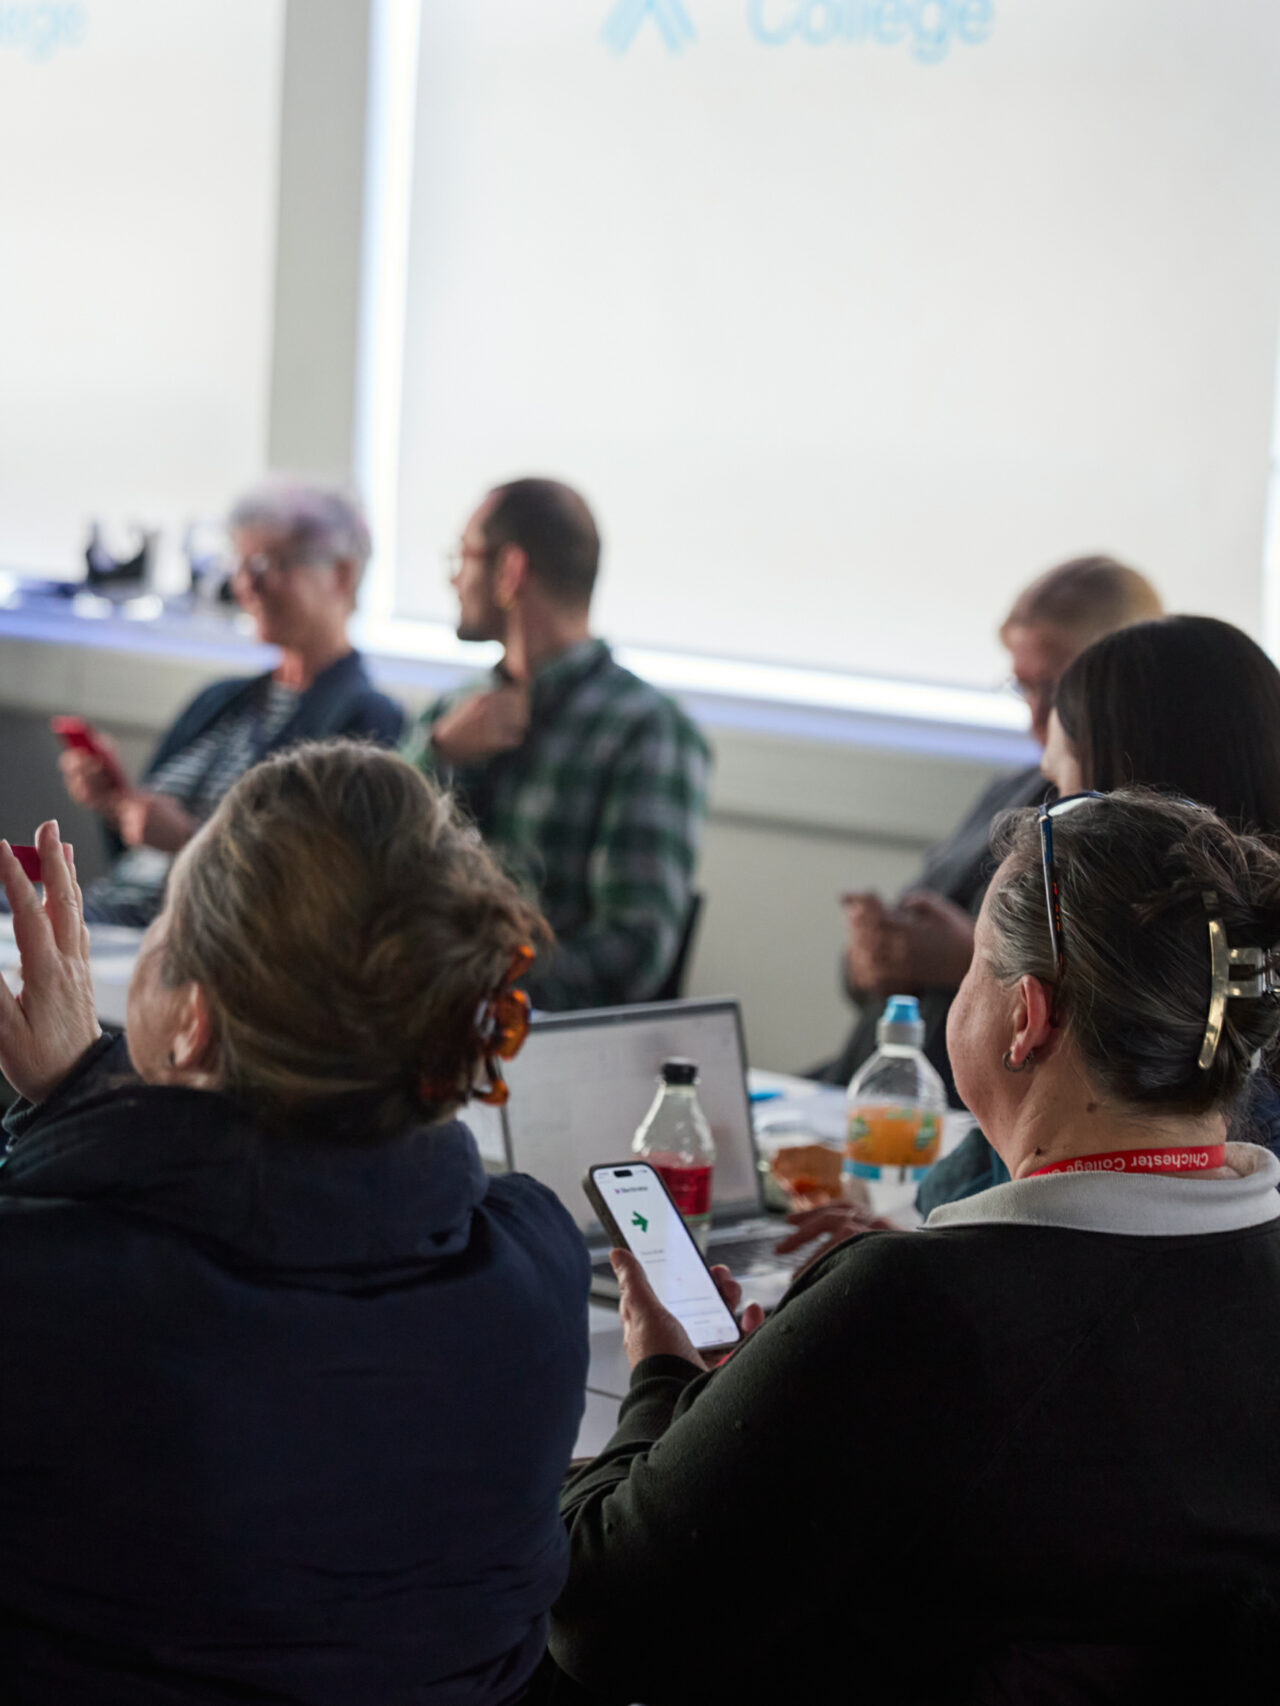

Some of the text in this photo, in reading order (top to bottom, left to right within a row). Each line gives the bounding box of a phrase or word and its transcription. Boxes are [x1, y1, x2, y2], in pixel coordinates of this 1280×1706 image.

[747, 0, 995, 65] College
[1066, 1157, 1126, 1172] College
[1131, 1152, 1209, 1168] Chichester
